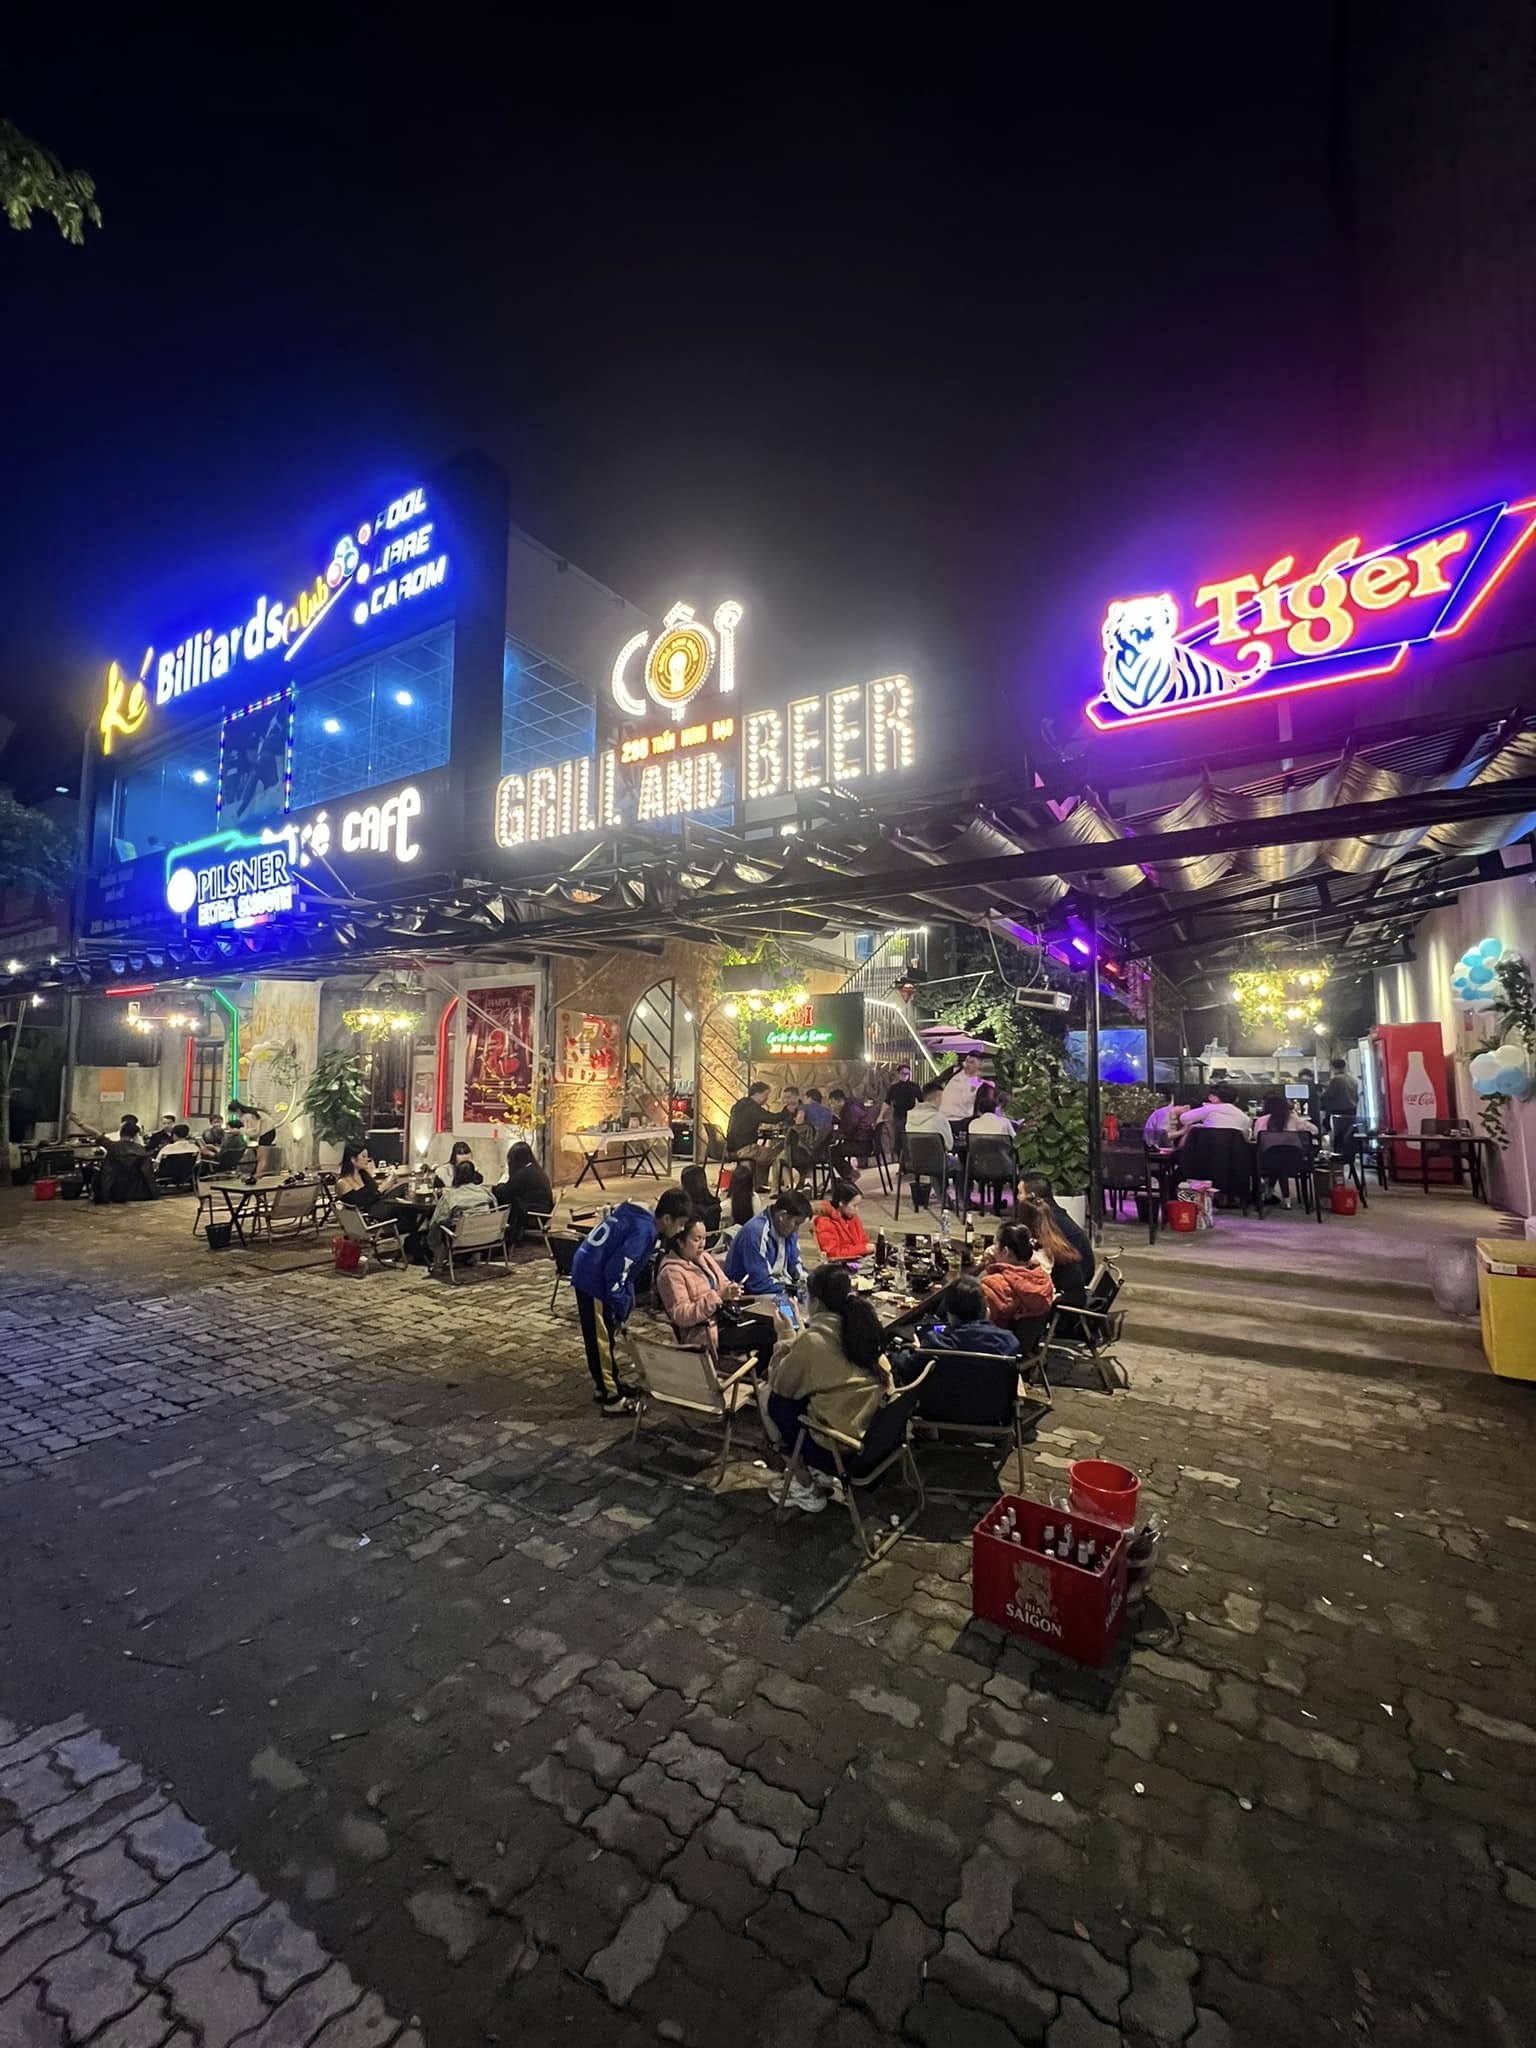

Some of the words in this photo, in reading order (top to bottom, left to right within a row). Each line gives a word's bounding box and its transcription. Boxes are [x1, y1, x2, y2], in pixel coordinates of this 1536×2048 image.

[374, 487, 427, 536] POOL
[372, 523, 434, 576] LIBRE
[370, 554, 448, 615] CAROM
[1196, 530, 1469, 657] Tiger
[156, 595, 284, 705] Billiards
[494, 750, 621, 848] GRILL
[637, 752, 722, 820] AND
[742, 674, 914, 800] BEER
[197, 850, 291, 903] PILSNER
[198, 898, 237, 926] EXTRA
[1006, 1602, 1063, 1638] SAIGON
